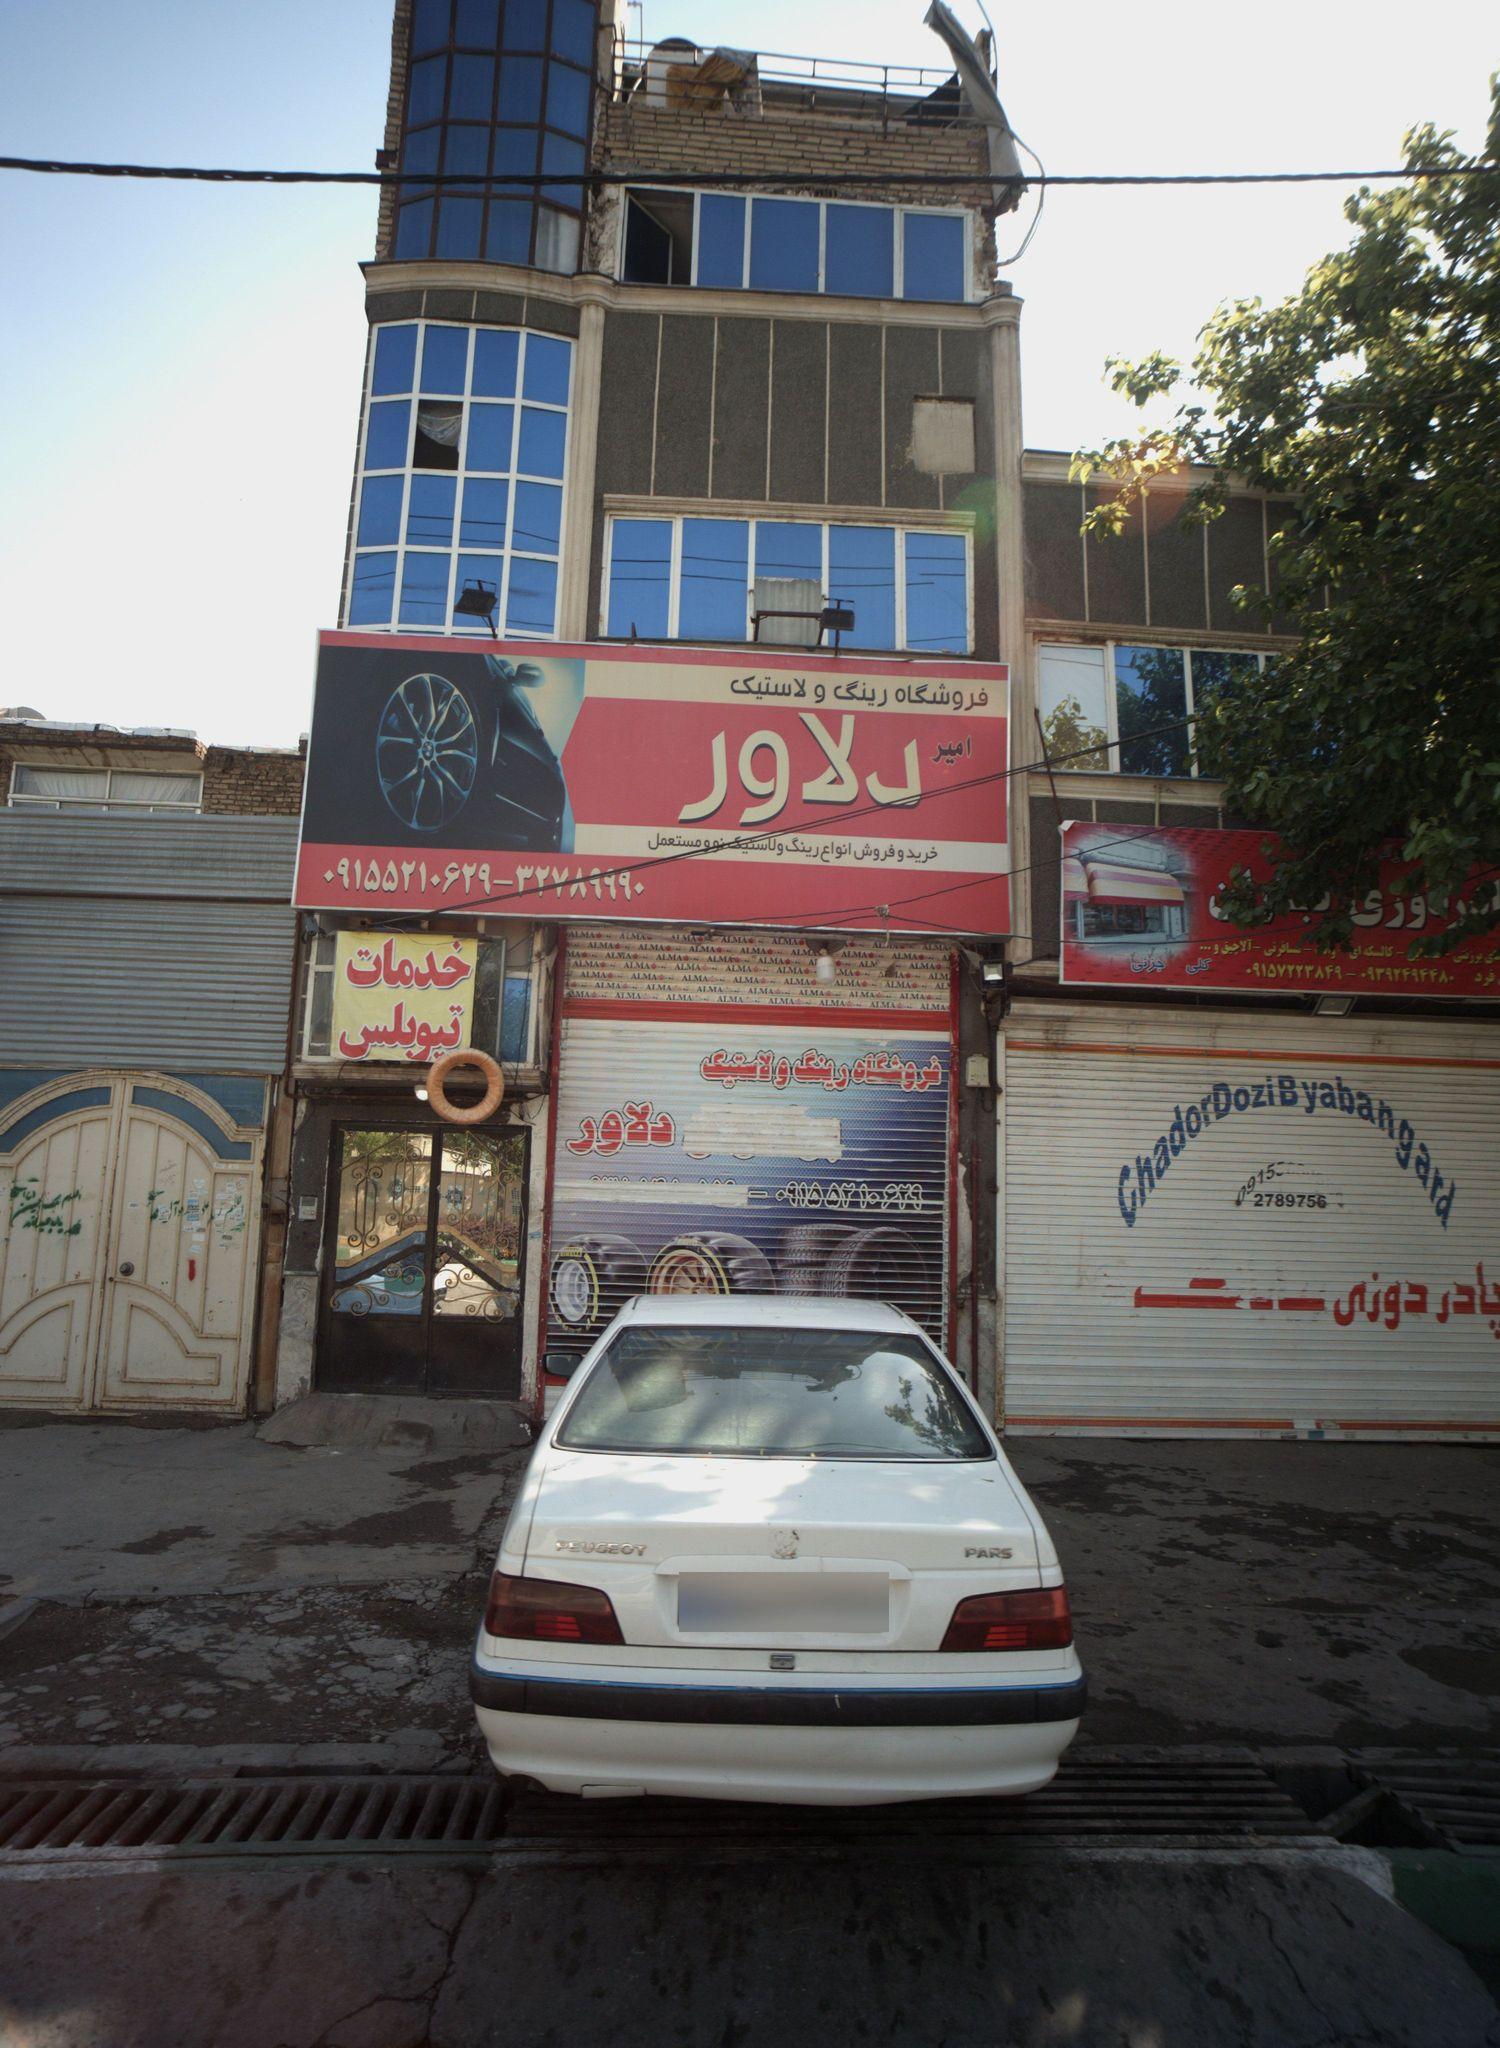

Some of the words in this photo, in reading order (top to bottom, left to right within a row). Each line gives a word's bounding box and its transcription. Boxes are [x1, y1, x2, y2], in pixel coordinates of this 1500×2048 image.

[730, 676, 807, 699] لاستیک
[814, 685, 826, 703] و
[833, 684, 888, 707] رینگ
[895, 683, 988, 711] فروشگاه
[932, 736, 972, 764] امیر
[678, 712, 922, 826] دلاور
[648, 833, 701, 850] مستعمل
[729, 836, 776, 854] لاستیک
[777, 842, 784, 856] و
[785, 837, 819, 857] رینگ
[820, 842, 851, 862] انواع
[854, 842, 895, 861] فروش
[898, 848, 904, 862] و
[906, 846, 938, 864] خرید
[345, 937, 472, 990] خدمات
[338, 1000, 464, 1061] تیوبلس
[699, 1049, 774, 1090] لاستیک
[772, 1057, 791, 1090] و
[792, 1049, 851, 1092] رینگ
[852, 1051, 942, 1092] فروشگاه
[566, 1101, 676, 1157] دلاور
[1254, 1193, 1327, 1209] 2789756
[1334, 1271, 1429, 1330] دوزی
[555, 1541, 647, 1557] PEUGEOT
[964, 1547, 1013, 1559] PARS
